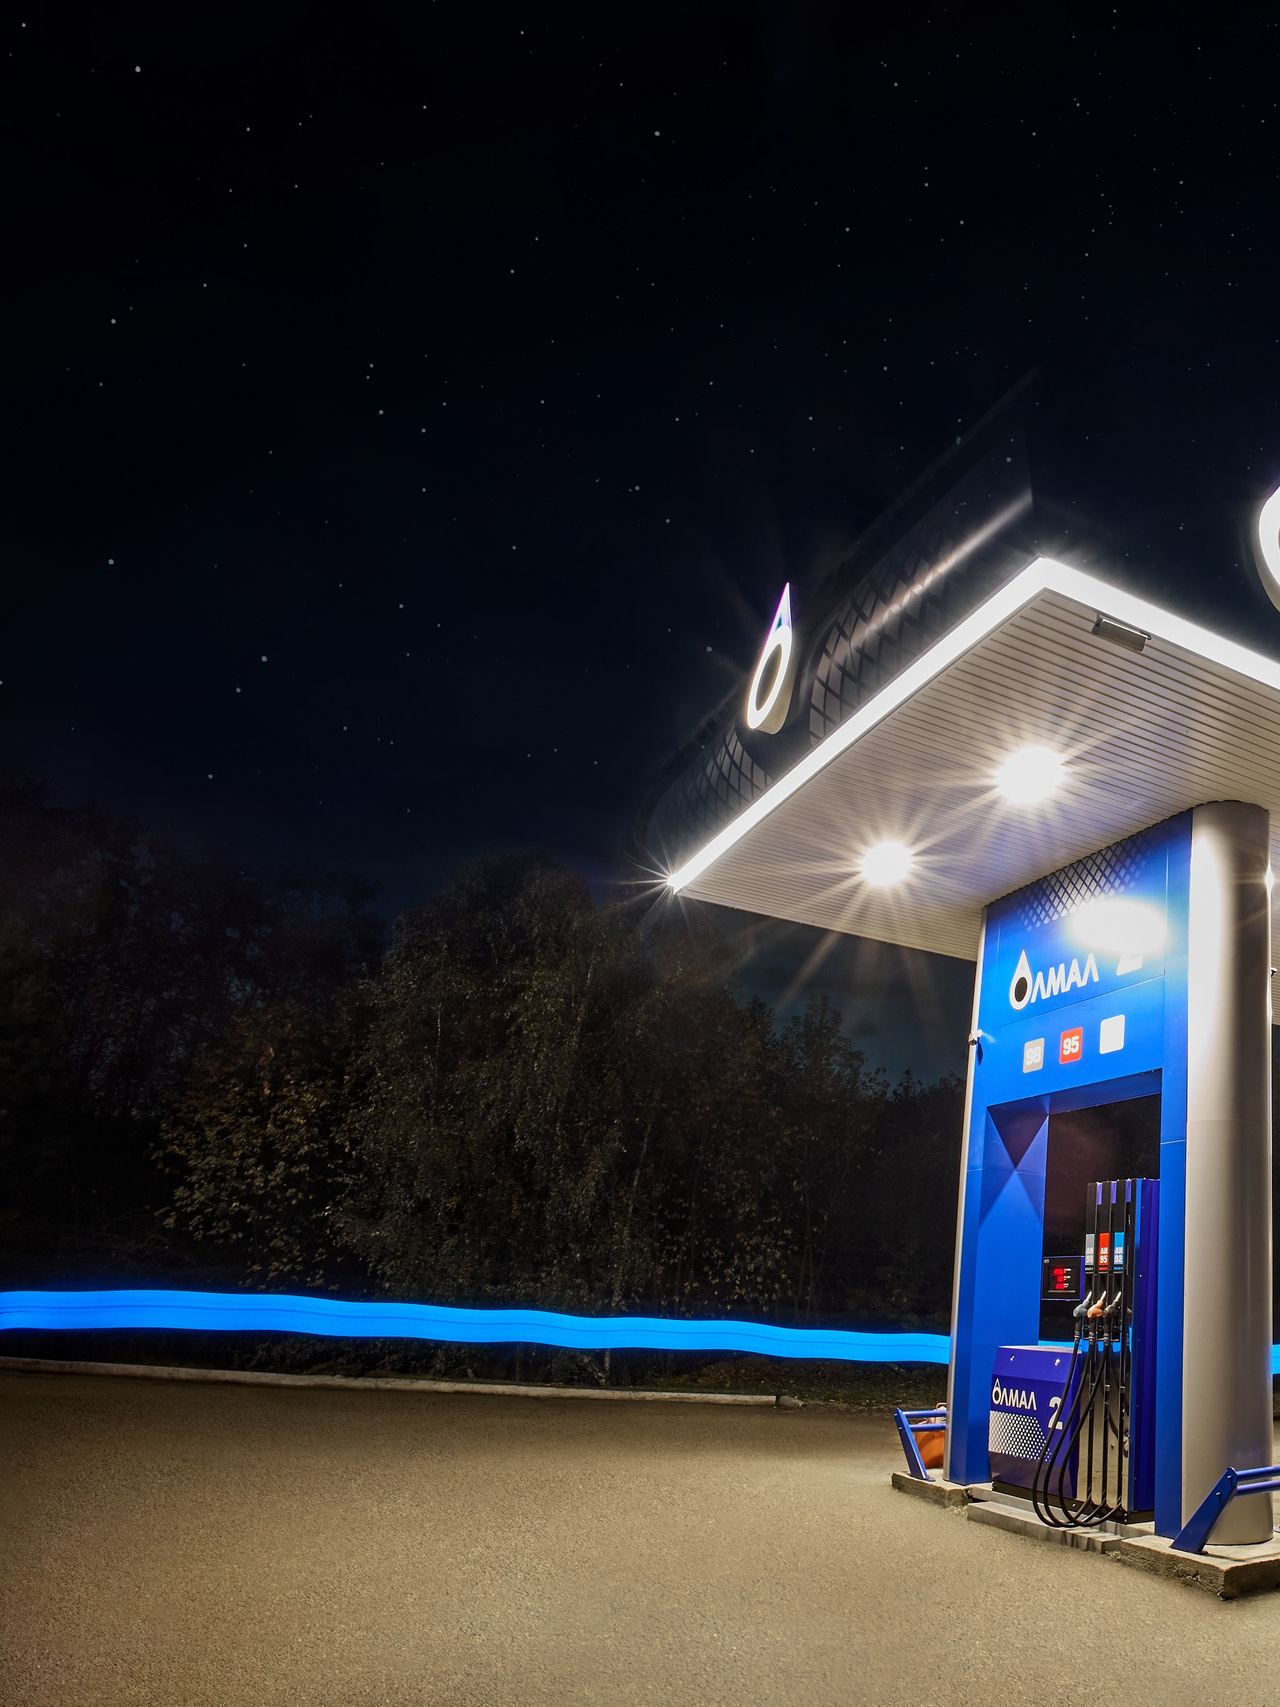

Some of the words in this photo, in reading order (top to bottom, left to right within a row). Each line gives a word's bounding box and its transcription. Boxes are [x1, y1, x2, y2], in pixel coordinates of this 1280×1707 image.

[1063, 1035, 1080, 1055] 95
[1025, 1046, 1041, 1065] 98
[1048, 1396, 1063, 1430] 2
